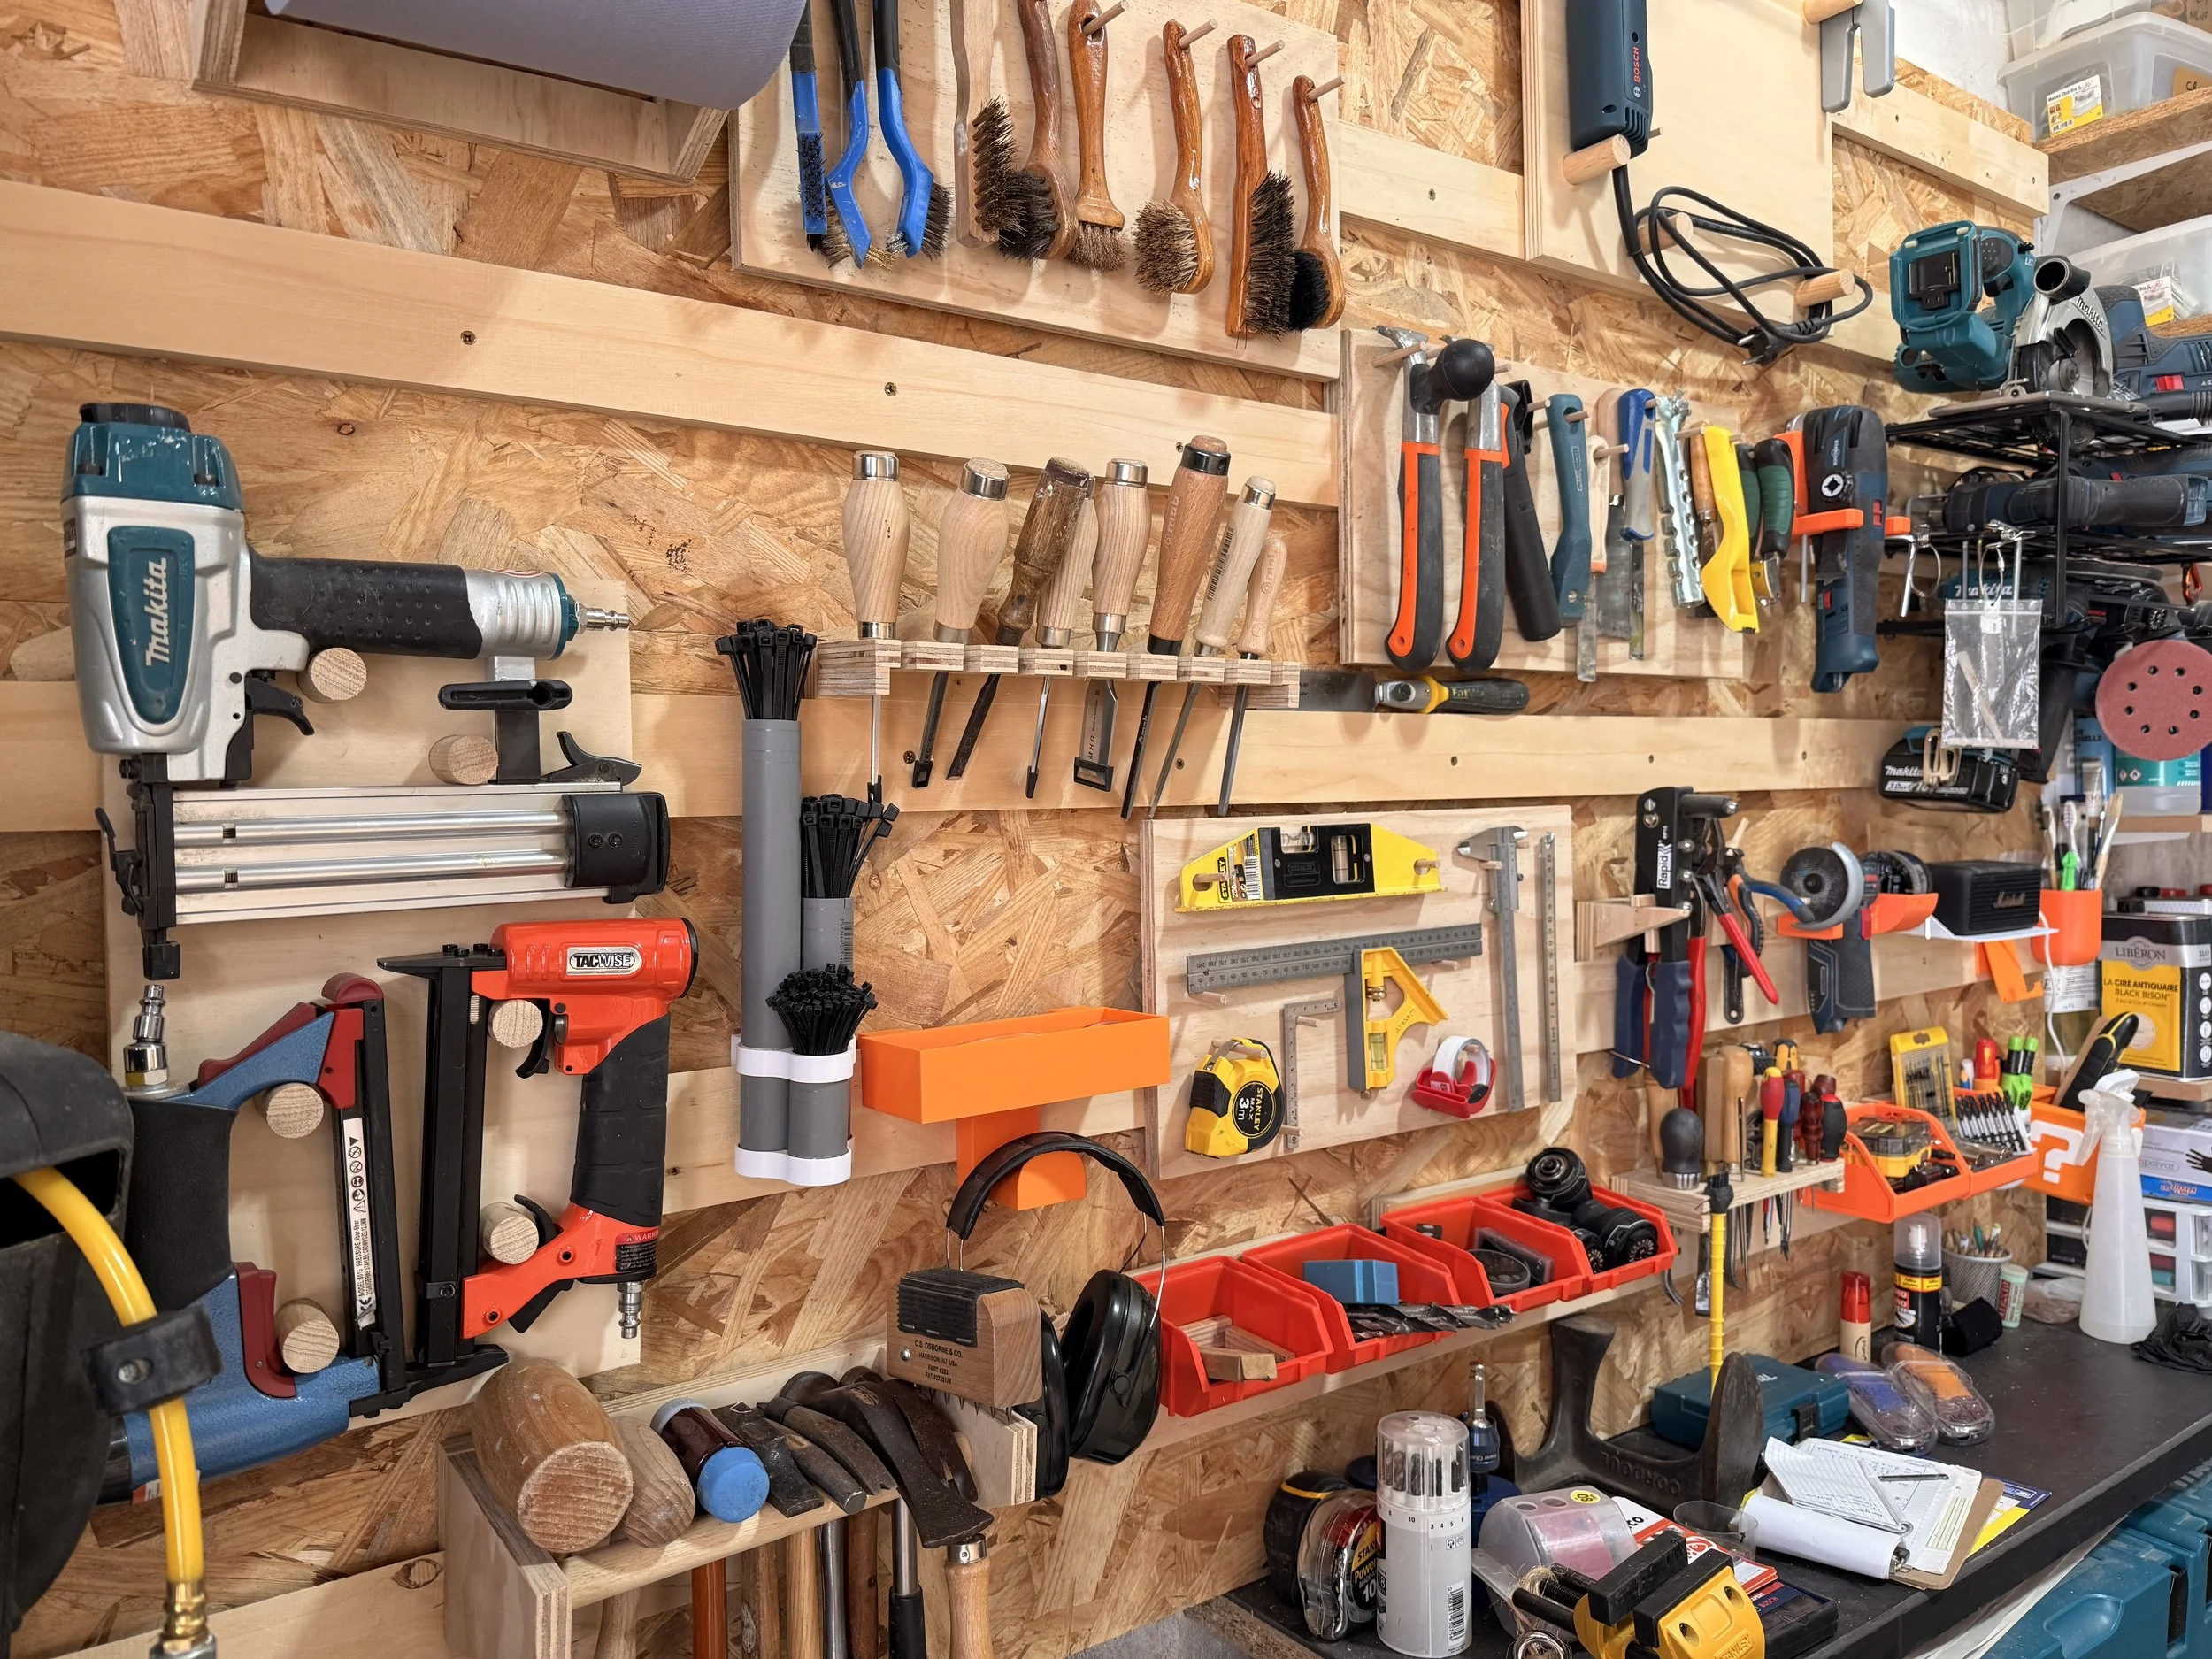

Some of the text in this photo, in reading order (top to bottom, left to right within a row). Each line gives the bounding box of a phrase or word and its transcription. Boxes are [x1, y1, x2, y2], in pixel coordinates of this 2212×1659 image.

[143, 557, 170, 666] Makita
[1218, 859, 1229, 898] STAEY
[1658, 855, 1669, 887] Rapid
[574, 954, 632, 968] TACWISE
[2116, 946, 2166, 960] LIBÉRON
[2115, 979, 2131, 987] CIRE
[2133, 981, 2178, 992] ANTIQUAIRE
[2115, 988, 2139, 998] BLACK
[1238, 1097, 1250, 1120] 3m
[1253, 1087, 1263, 1131] STANLEY
[925, 1342, 949, 1355] OSBORNE
[954, 1349, 963, 1358] CO.
[949, 1359, 957, 1368] USA
[1358, 1541, 1376, 1563] STAN
[1363, 1578, 1377, 1602] 10
